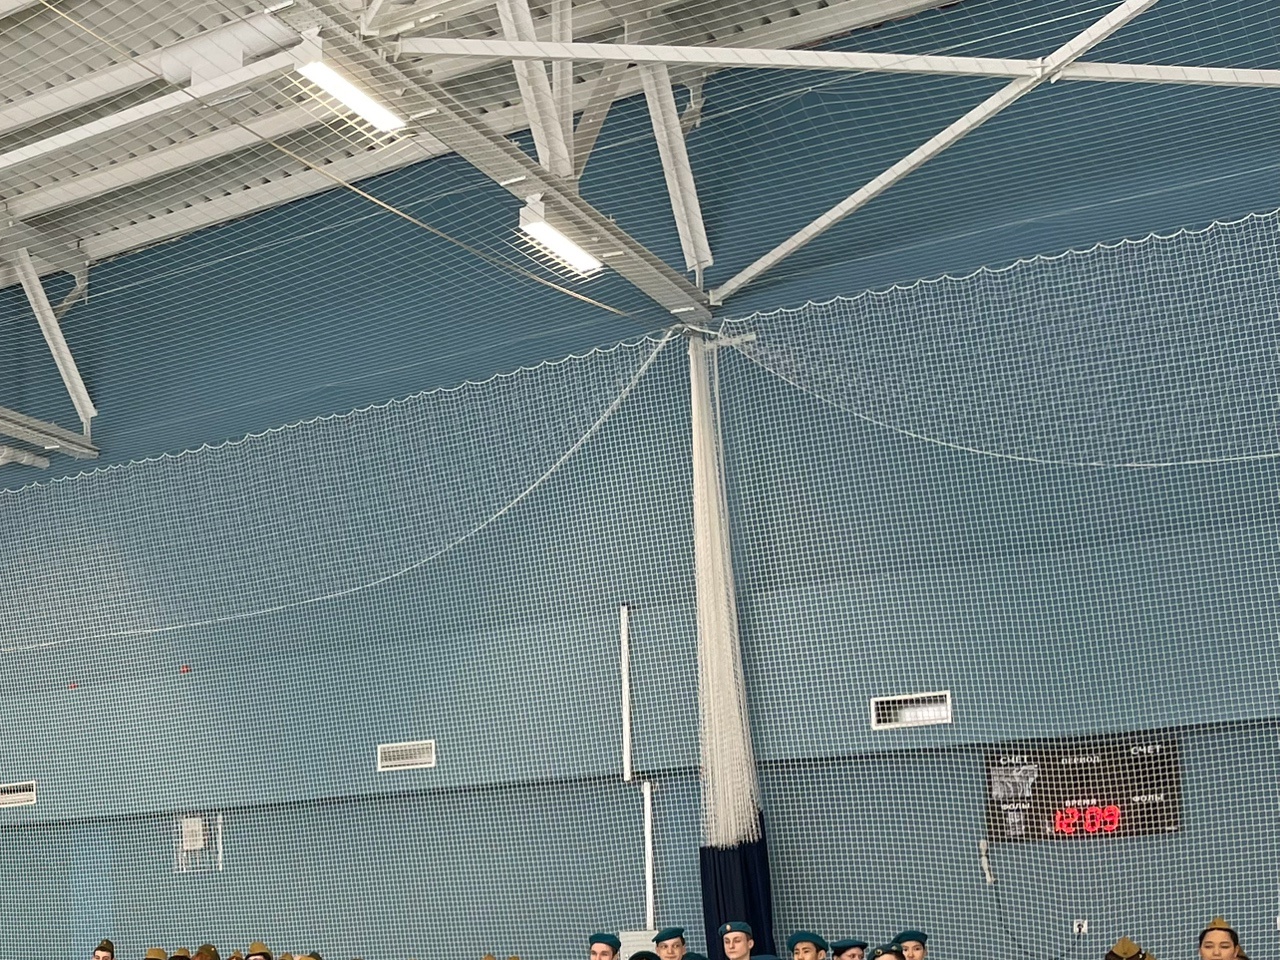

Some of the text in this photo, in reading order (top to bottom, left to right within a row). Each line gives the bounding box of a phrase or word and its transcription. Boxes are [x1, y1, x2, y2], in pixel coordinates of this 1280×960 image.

[1131, 745, 1161, 755] СЧЕТ
[1000, 754, 1028, 765] СЧЕТ
[1133, 793, 1164, 802] ФОЛЫ
[1065, 798, 1097, 807] ВРЕМЯ
